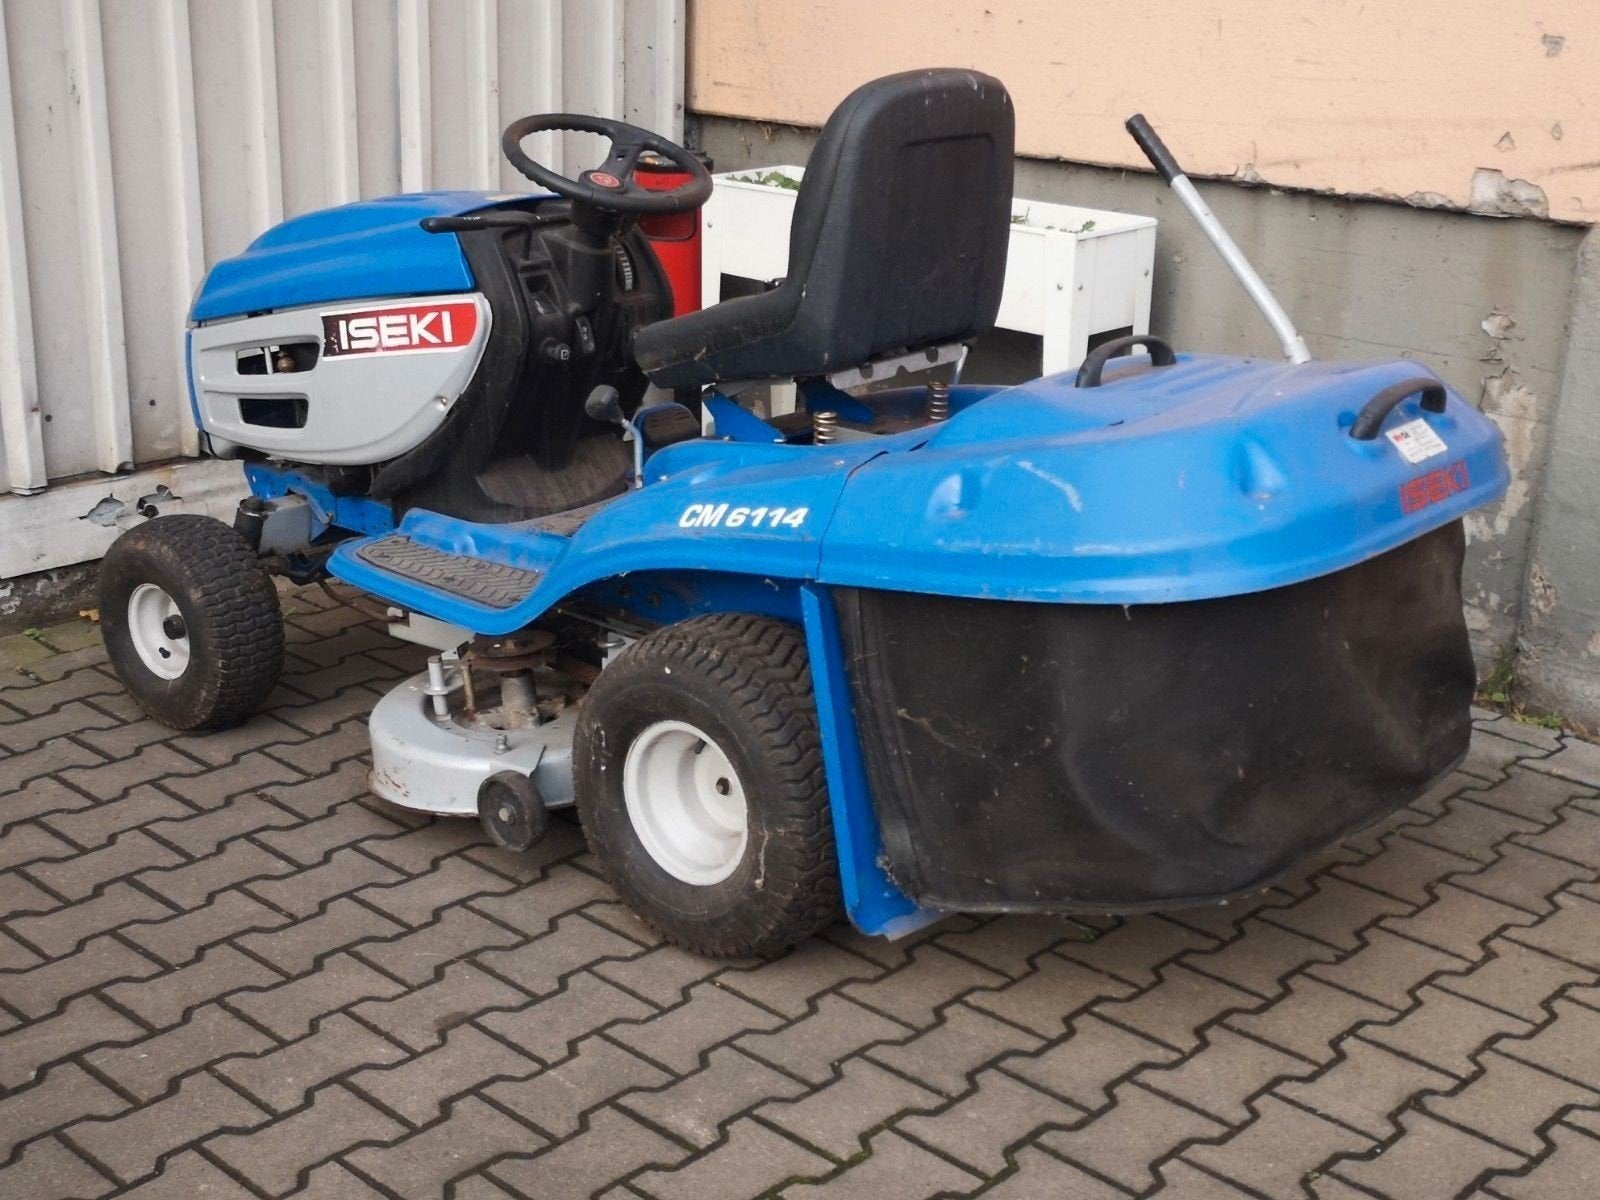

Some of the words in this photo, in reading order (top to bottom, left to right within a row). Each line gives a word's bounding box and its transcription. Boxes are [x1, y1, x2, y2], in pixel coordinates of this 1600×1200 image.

[338, 310, 453, 350] ISEKI
[1399, 459, 1470, 514] ISEKI
[678, 503, 729, 528] CM
[725, 507, 809, 528] 6114
